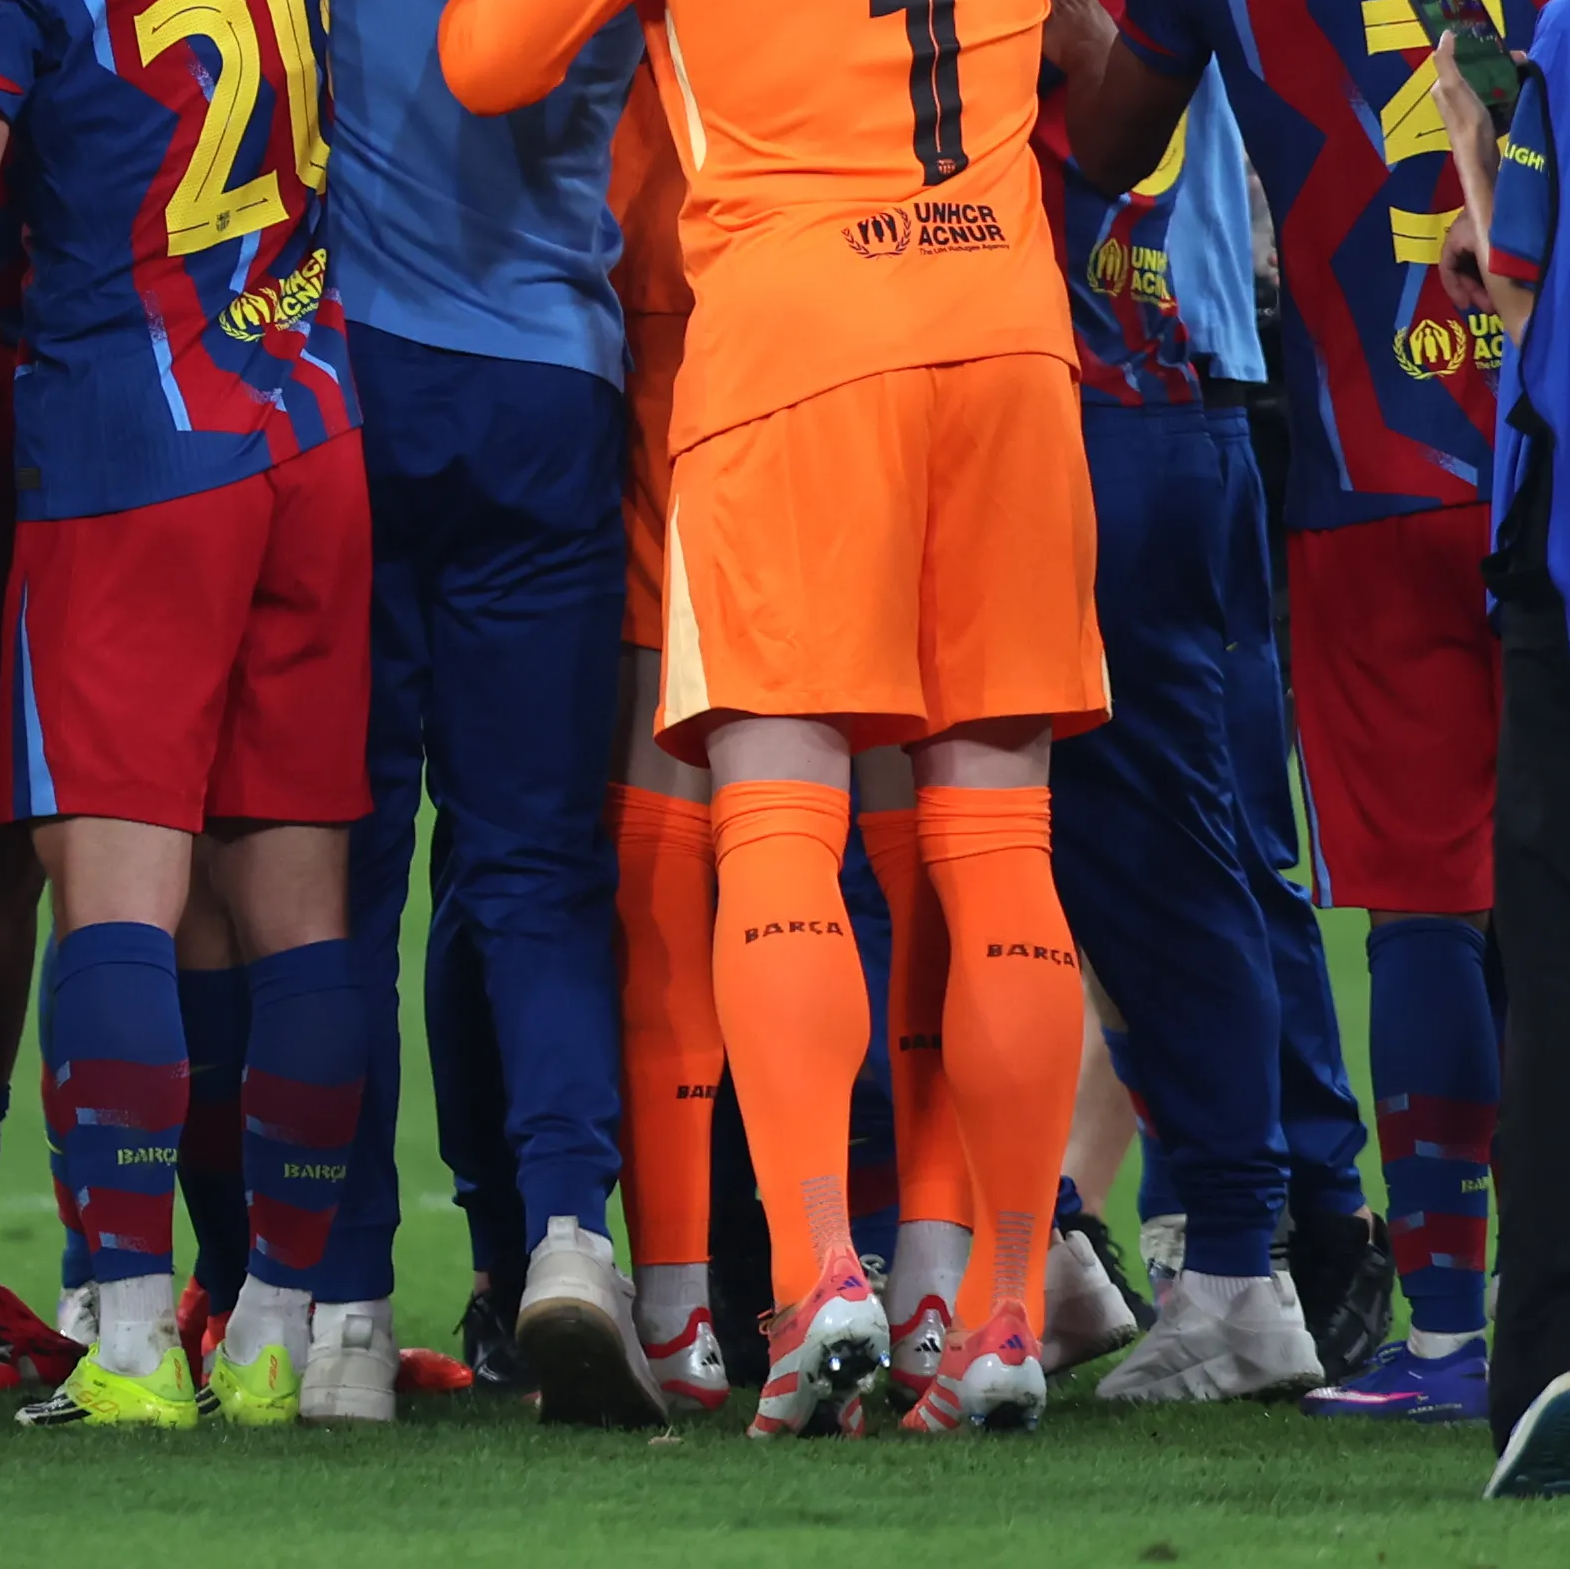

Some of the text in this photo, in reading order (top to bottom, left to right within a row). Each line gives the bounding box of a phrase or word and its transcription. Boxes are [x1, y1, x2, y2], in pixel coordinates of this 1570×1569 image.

[913, 202, 997, 224] UNHCR
[917, 224, 1006, 246] ACNUR
[1131, 245, 1168, 272] UNH
[1468, 313, 1504, 337] UN
[1474, 334, 1504, 360] AC
[745, 921, 844, 944] BARÇA
[986, 943, 1076, 969] BARÇA
